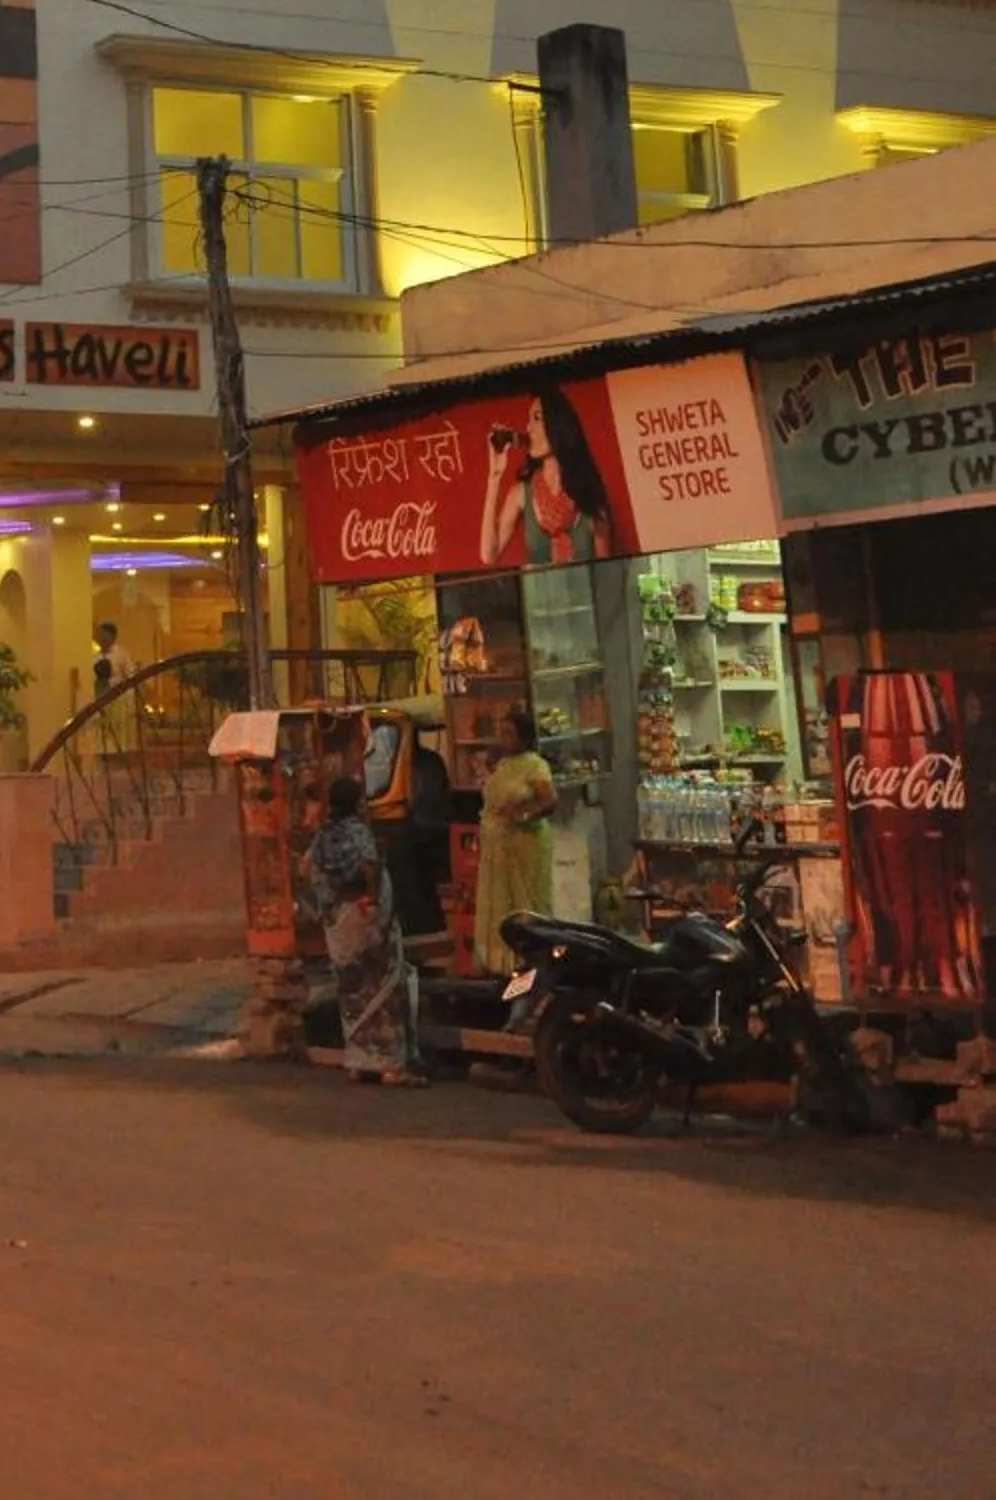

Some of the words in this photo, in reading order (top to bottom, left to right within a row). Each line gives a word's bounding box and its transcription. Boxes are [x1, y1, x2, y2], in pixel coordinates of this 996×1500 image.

[32, 328, 190, 386] Haveli
[826, 333, 976, 411] THE
[635, 398, 726, 437] SHWETA
[414, 420, 464, 482] रहो
[638, 430, 739, 471] GENERAL
[658, 467, 731, 501] STORE
[341, 501, 437, 561] Coca-Cola
[845, 752, 966, 811] Coca-Cola
